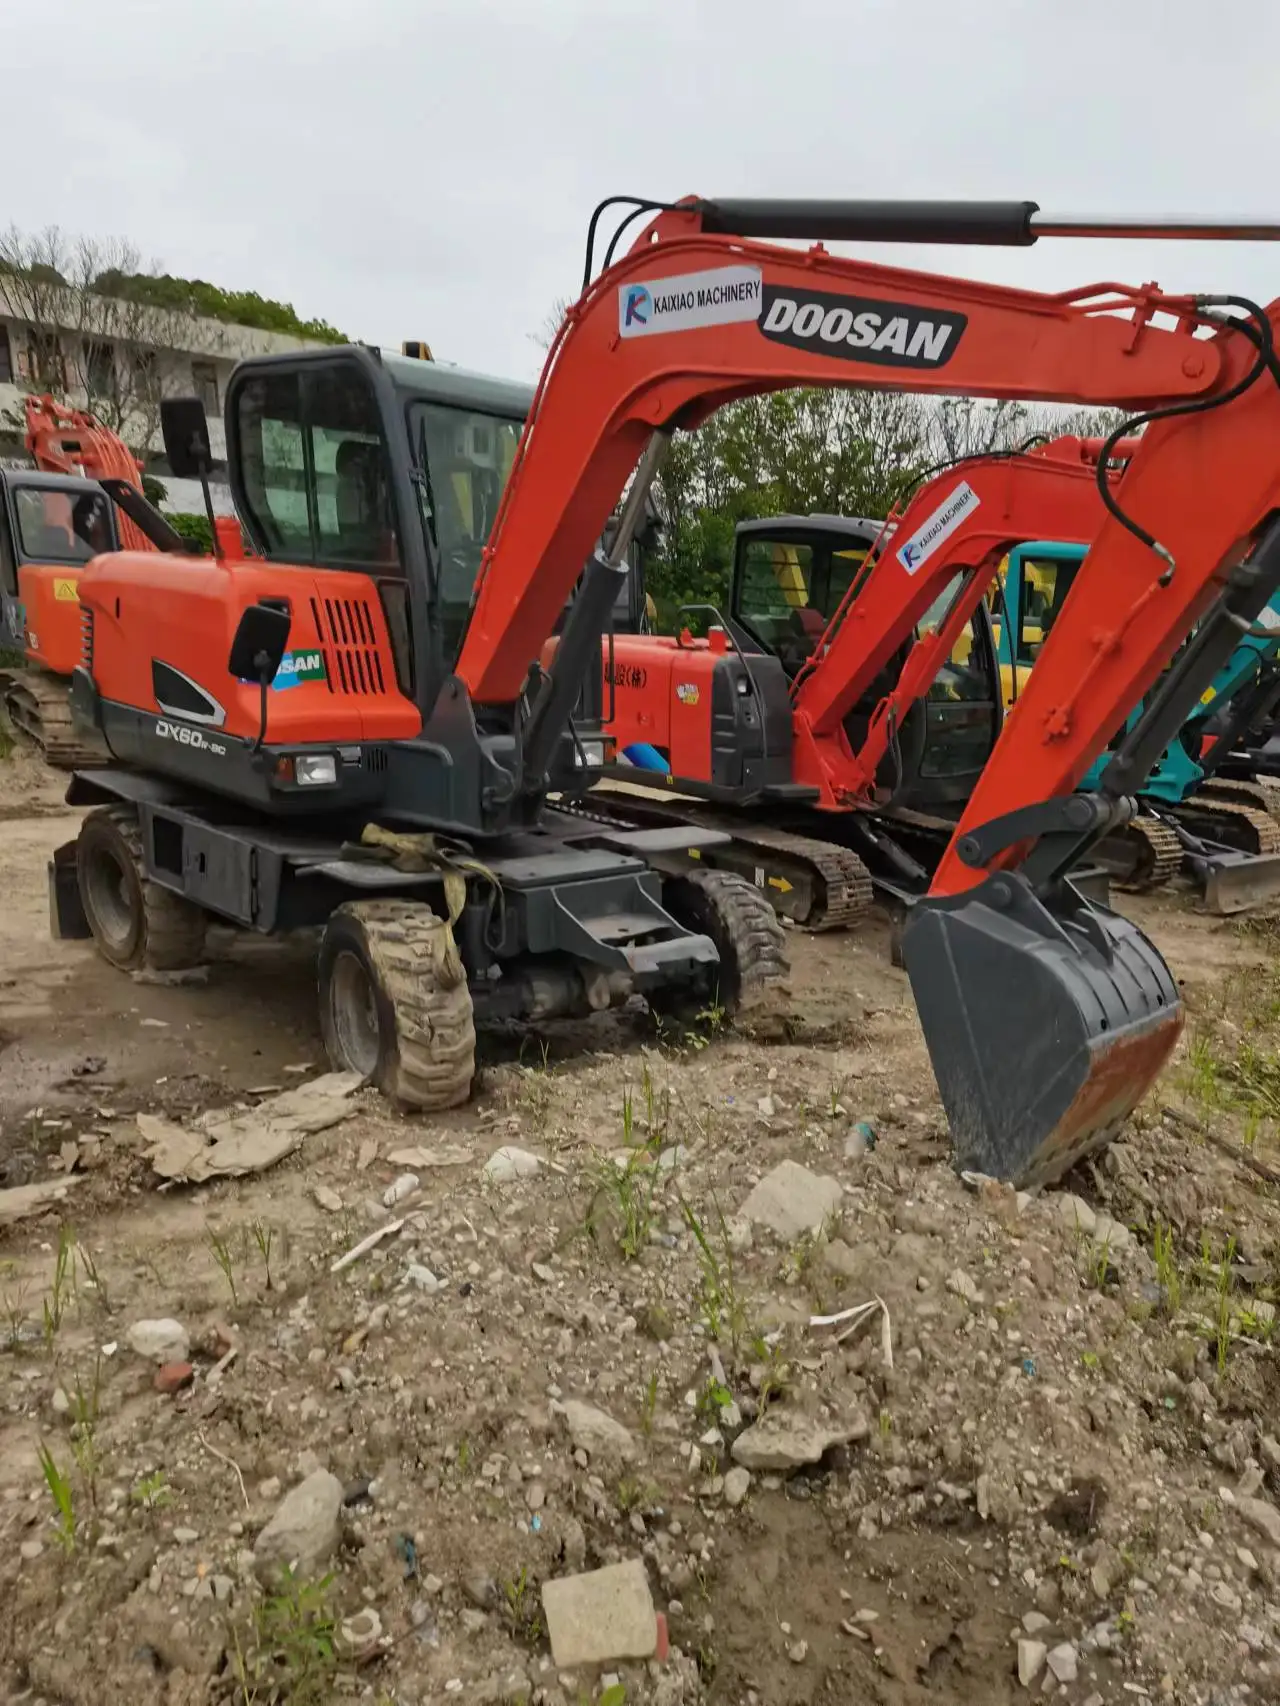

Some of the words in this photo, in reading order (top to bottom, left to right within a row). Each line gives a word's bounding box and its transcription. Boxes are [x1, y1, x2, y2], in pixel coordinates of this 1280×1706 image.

[654, 291, 694, 314] KAIXIAO
[697, 280, 761, 308] MACHINERY
[763, 298, 952, 361] DOOSAN
[276, 654, 320, 677] SAN
